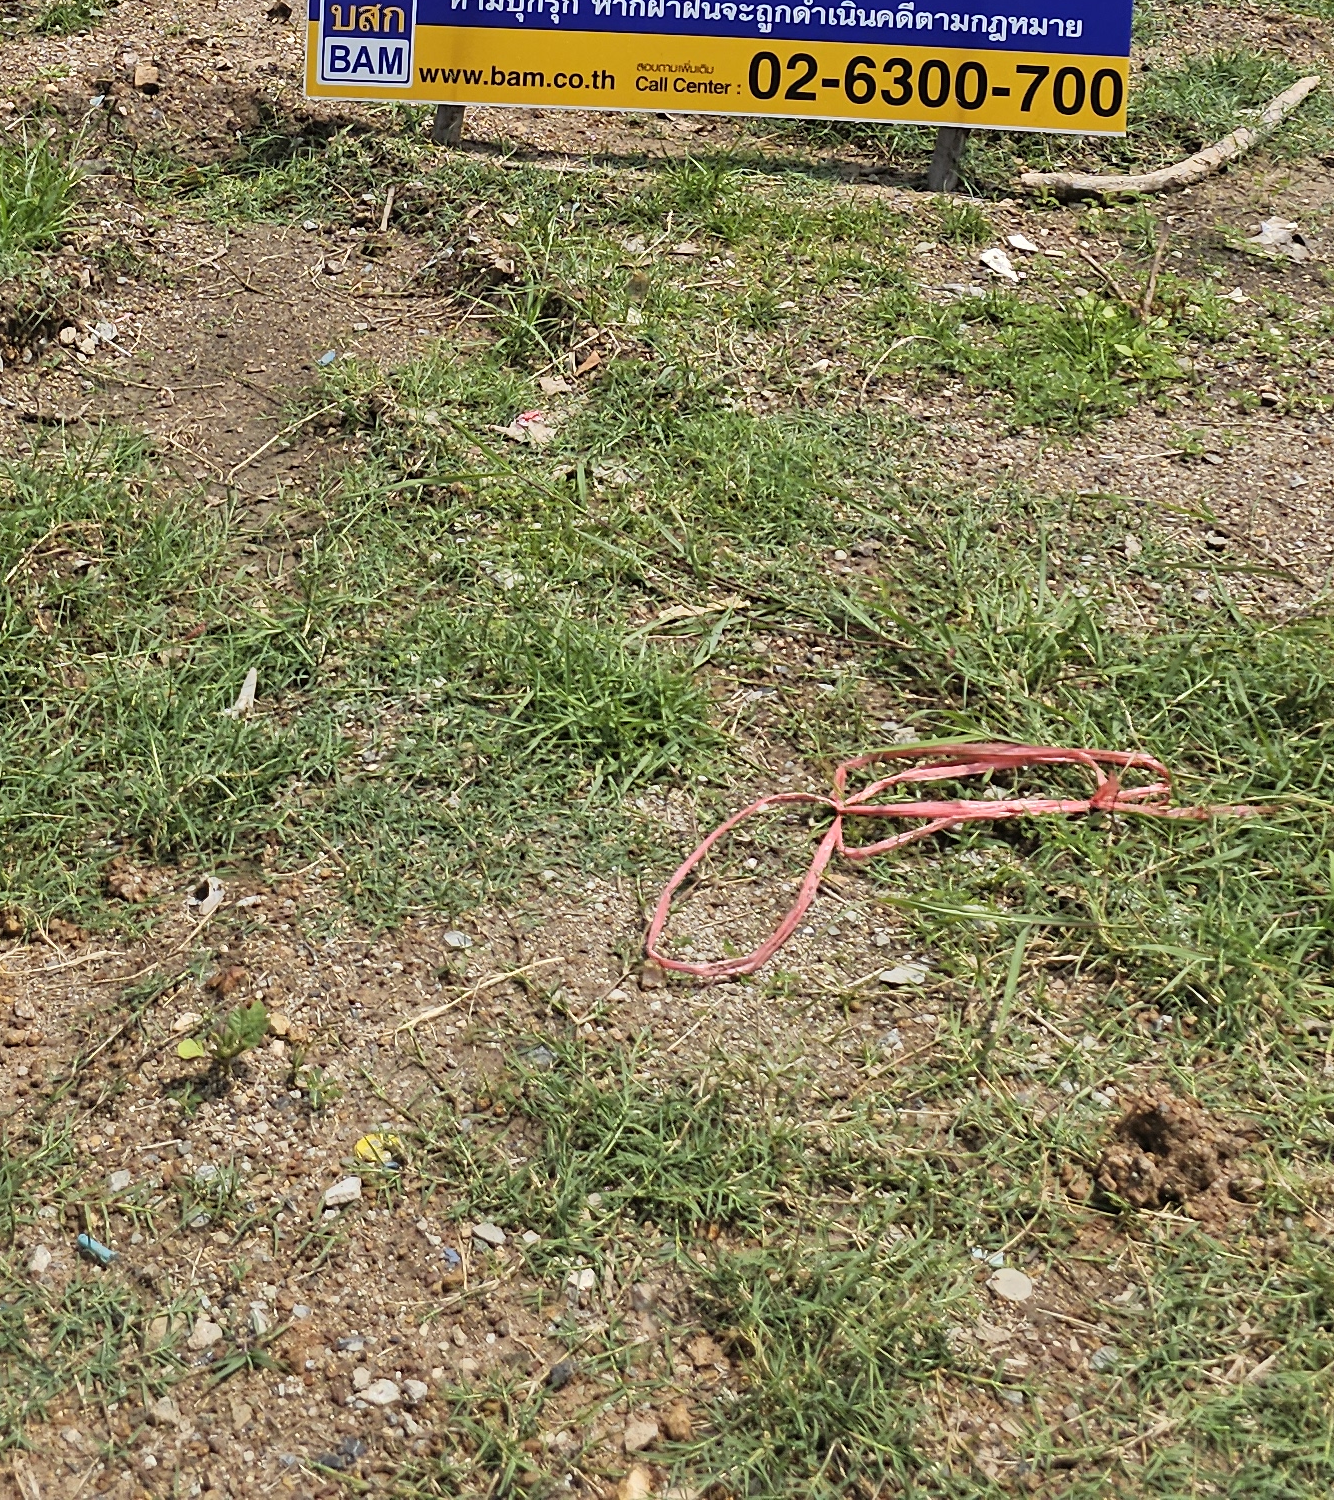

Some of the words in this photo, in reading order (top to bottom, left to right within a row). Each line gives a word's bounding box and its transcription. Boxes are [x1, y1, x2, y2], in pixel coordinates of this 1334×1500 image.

[330, 3, 406, 34] บสก
[328, 44, 404, 76] BAM
[418, 64, 616, 91] www.bam.co.th
[635, 75, 668, 93] Call
[673, 77, 732, 95] Center
[747, 51, 1124, 118] 02-6300-700
